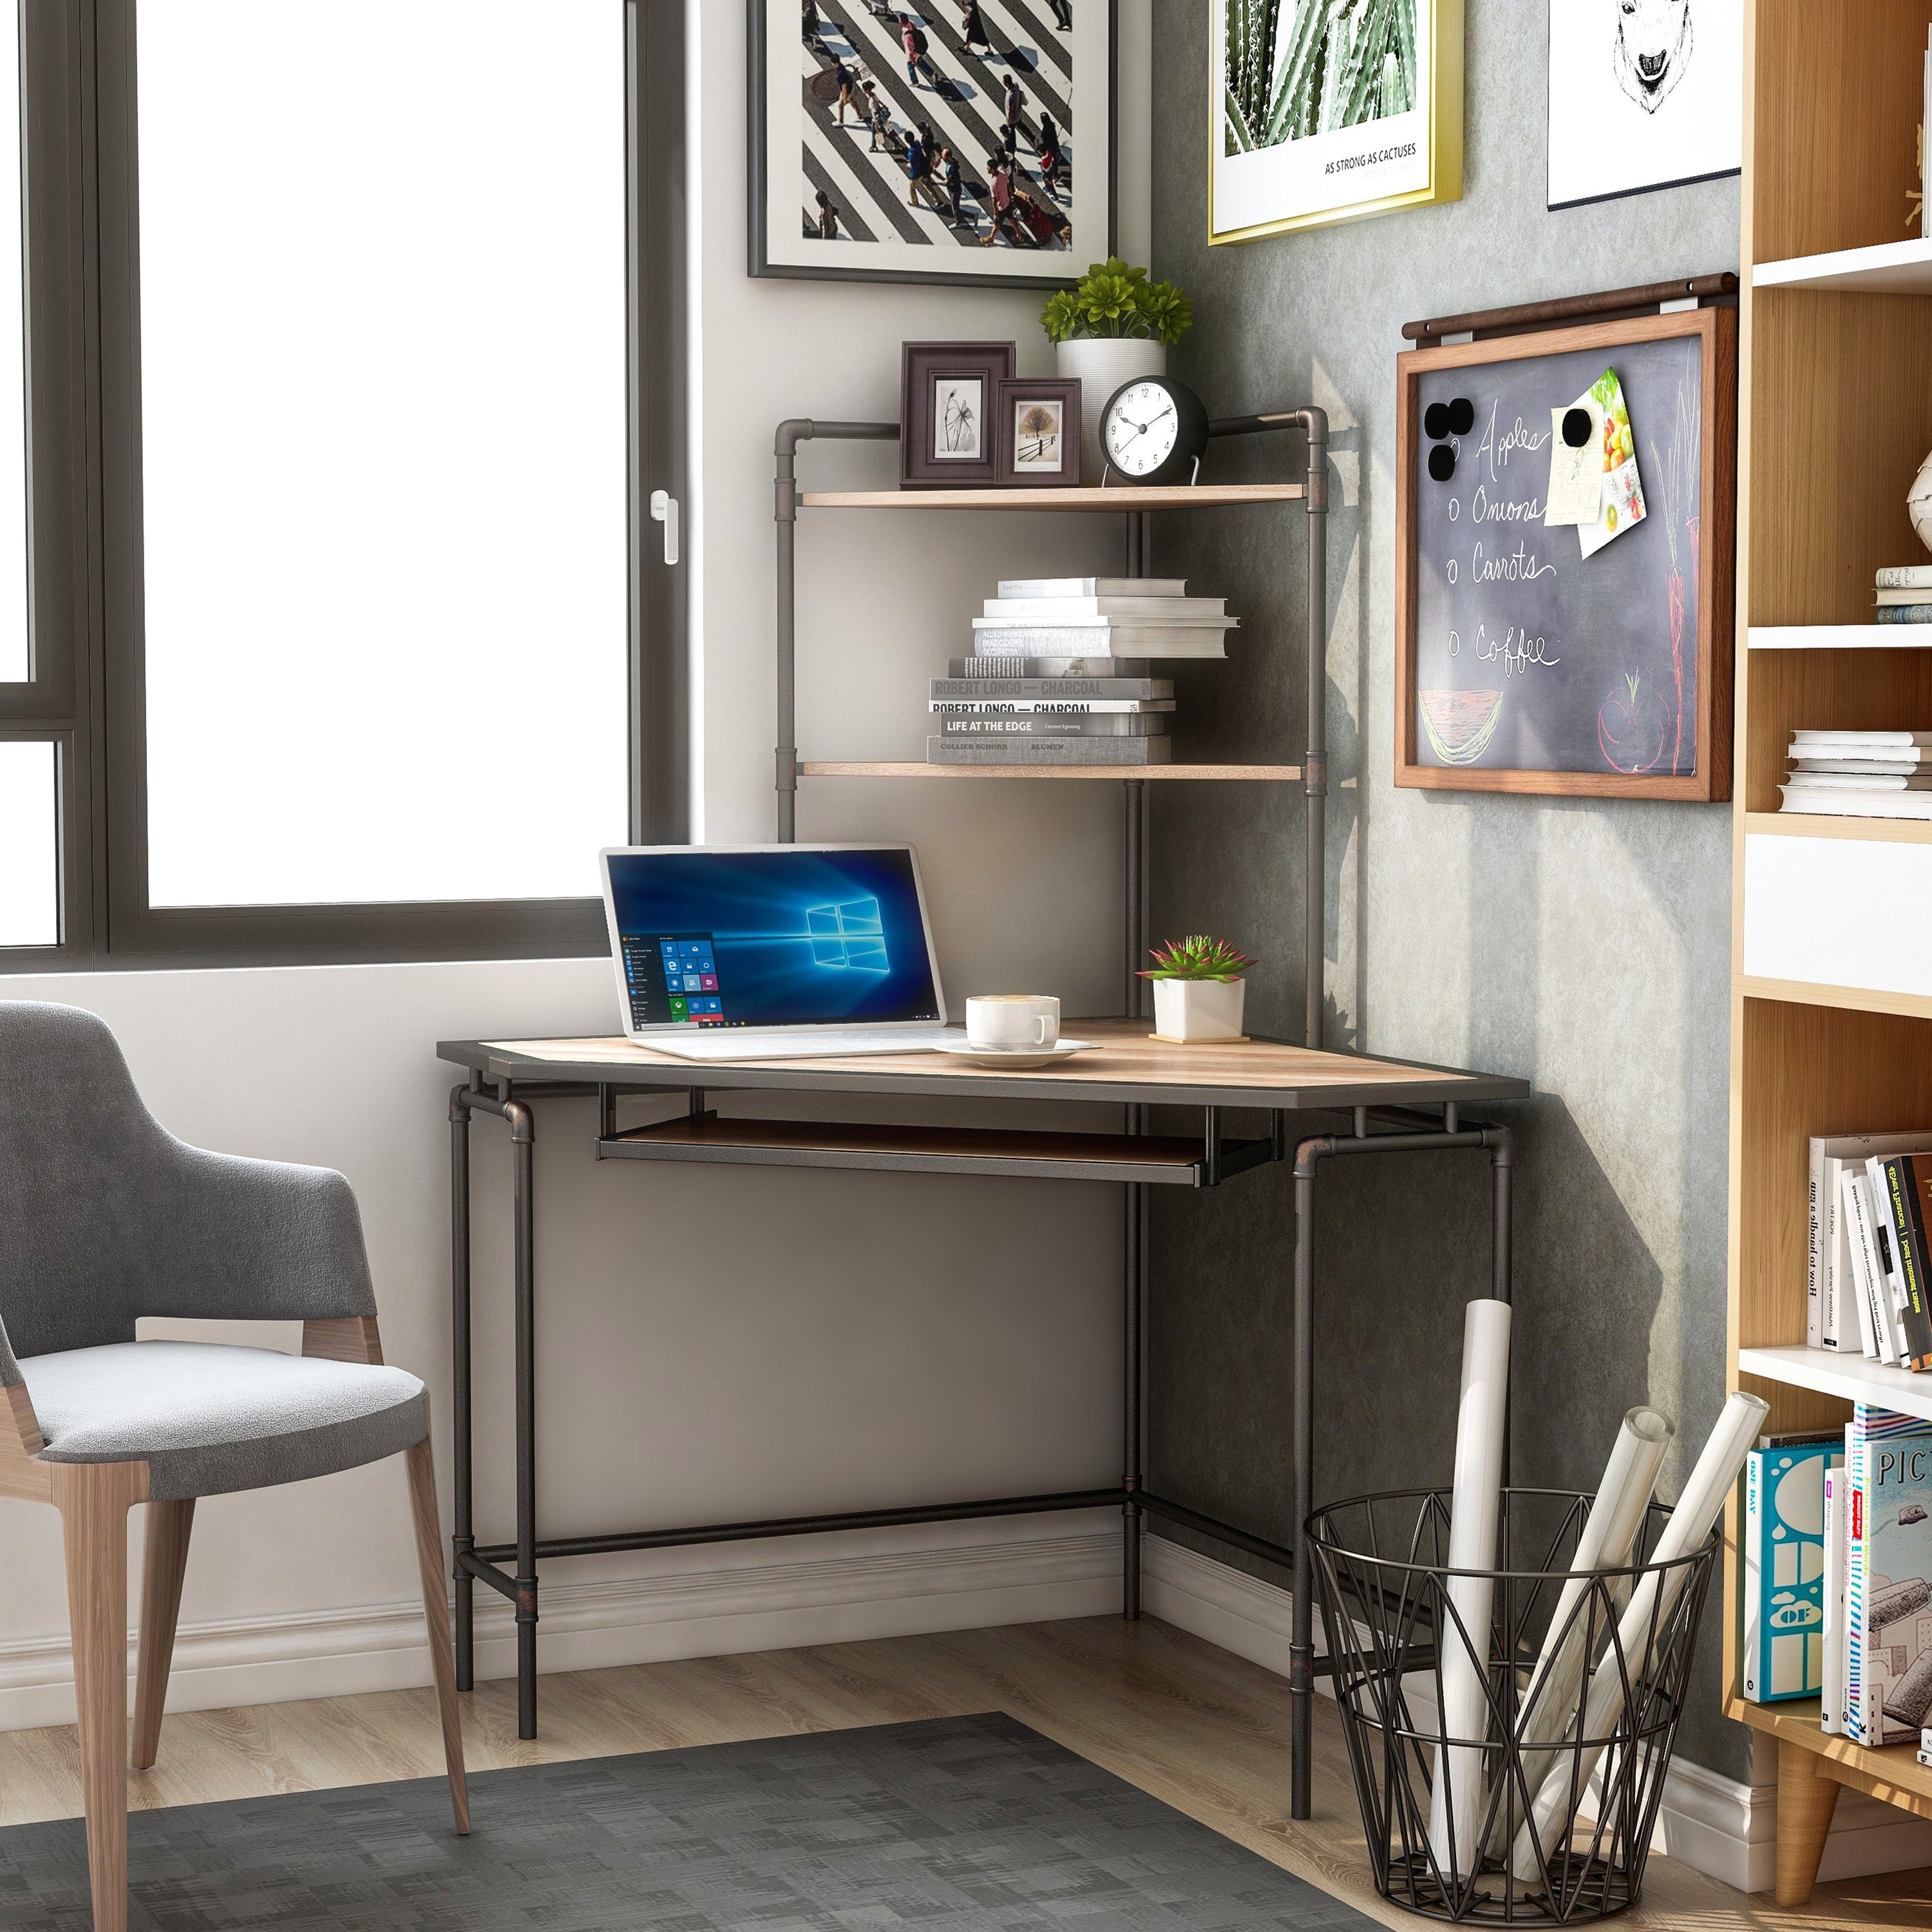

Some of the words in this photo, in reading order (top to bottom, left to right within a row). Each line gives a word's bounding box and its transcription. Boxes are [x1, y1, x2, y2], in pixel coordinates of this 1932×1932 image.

[1325, 162, 1334, 175] AS
[1336, 155, 1365, 172] STRONG
[1367, 152, 1377, 165] AS
[1379, 143, 1416, 162] CACTUSES
[1128, 393, 1133, 403] 11
[1141, 388, 1149, 398] 12
[1158, 392, 1160, 401] 1
[1115, 407, 1122, 417] 10
[1112, 425, 1116, 435] 9
[1170, 422, 1175, 433] 3
[1475, 398, 1551, 482] Apples
[1114, 442, 1119, 453] 8
[1124, 455, 1129, 465] 7
[1153, 454, 1158, 464] 5
[1139, 460, 1143, 469] 6
[1472, 486, 1546, 523] Onions
[1472, 541, 1557, 581] Carrots
[1475, 625, 1560, 679] Coffee
[935, 681, 980, 695] ROBERT
[984, 681, 1021, 695] LONGO
[1041, 681, 1103, 695] CHARCOAL
[933, 704, 976, 712] ROBERT
[947, 721, 967, 731] LIFE
[969, 721, 982, 731] AT
[984, 721, 1003, 731] THE
[1005, 721, 1032, 731] EDGE
[1879, 1448, 1932, 1486] PIC
